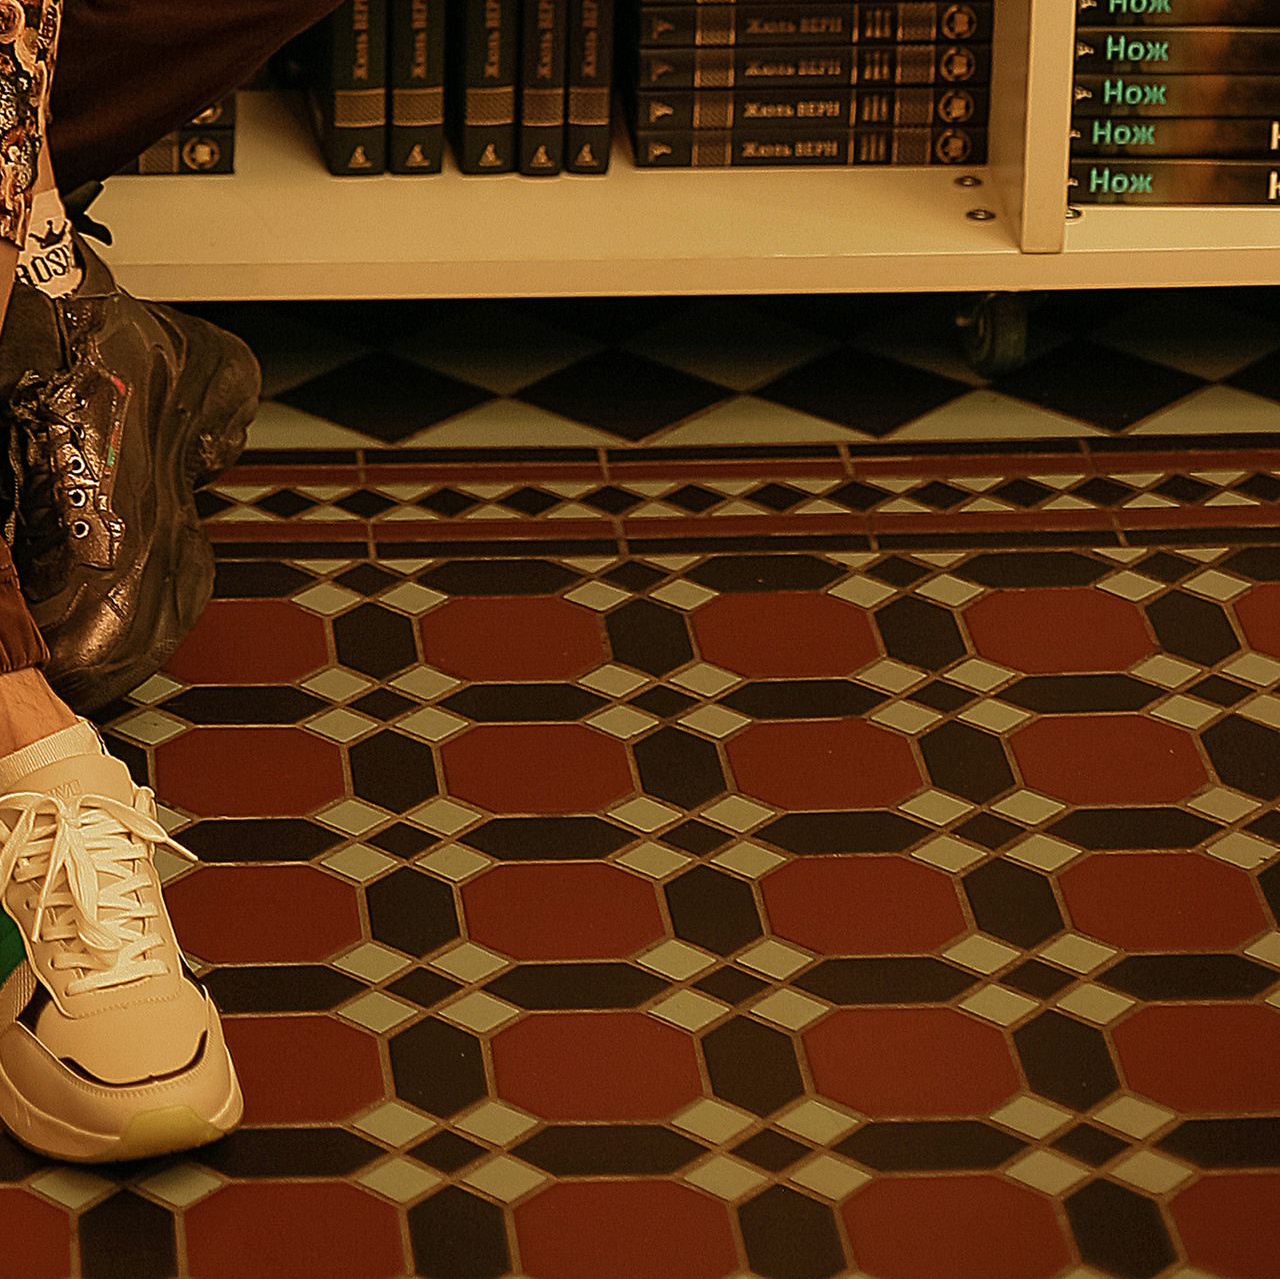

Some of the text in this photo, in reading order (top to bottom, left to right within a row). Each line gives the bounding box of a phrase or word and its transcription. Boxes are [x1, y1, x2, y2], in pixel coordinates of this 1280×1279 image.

[1105, 34, 1170, 62] Нож
[1102, 79, 1168, 106] Нож
[1091, 120, 1156, 147] Нож
[1088, 167, 1154, 194] Нож
